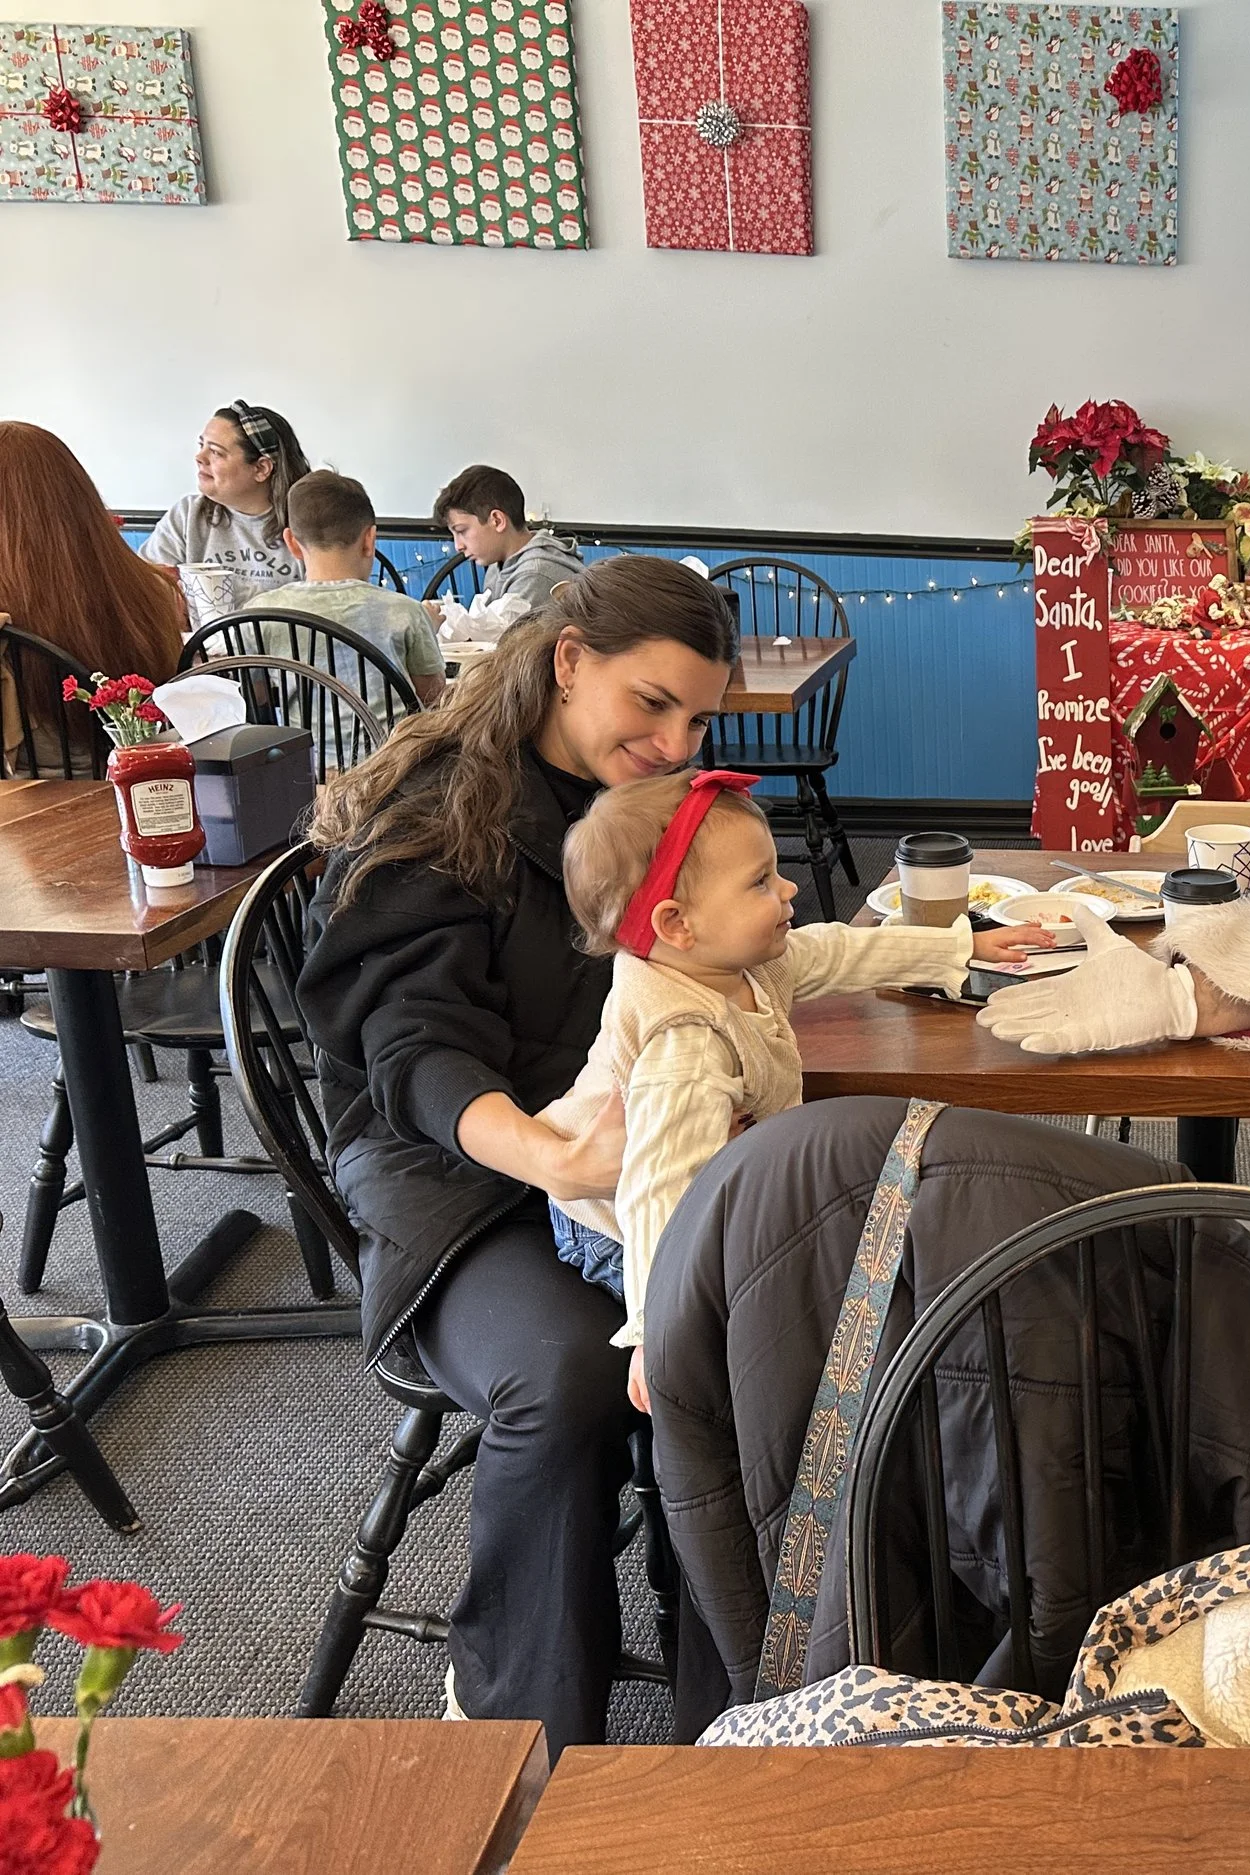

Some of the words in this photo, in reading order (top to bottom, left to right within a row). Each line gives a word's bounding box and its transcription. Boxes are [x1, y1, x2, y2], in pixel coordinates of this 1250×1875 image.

[1114, 533, 1138, 553] DEAR
[1144, 534, 1180, 556] SANTA,
[250, 570, 273, 578] FARM
[1034, 545, 1088, 578] Dear
[1117, 558, 1132, 576] DID
[1136, 558, 1158, 577] YOU
[1163, 558, 1186, 577] LIKE
[1190, 558, 1212, 577] OUR
[1035, 586, 1103, 631] Santa,
[1060, 640, 1083, 682] I
[1037, 689, 1111, 723] Promize
[1072, 734, 1112, 776] been
[148, 783, 174, 793] HEINZ
[1066, 777, 1113, 816] good!
